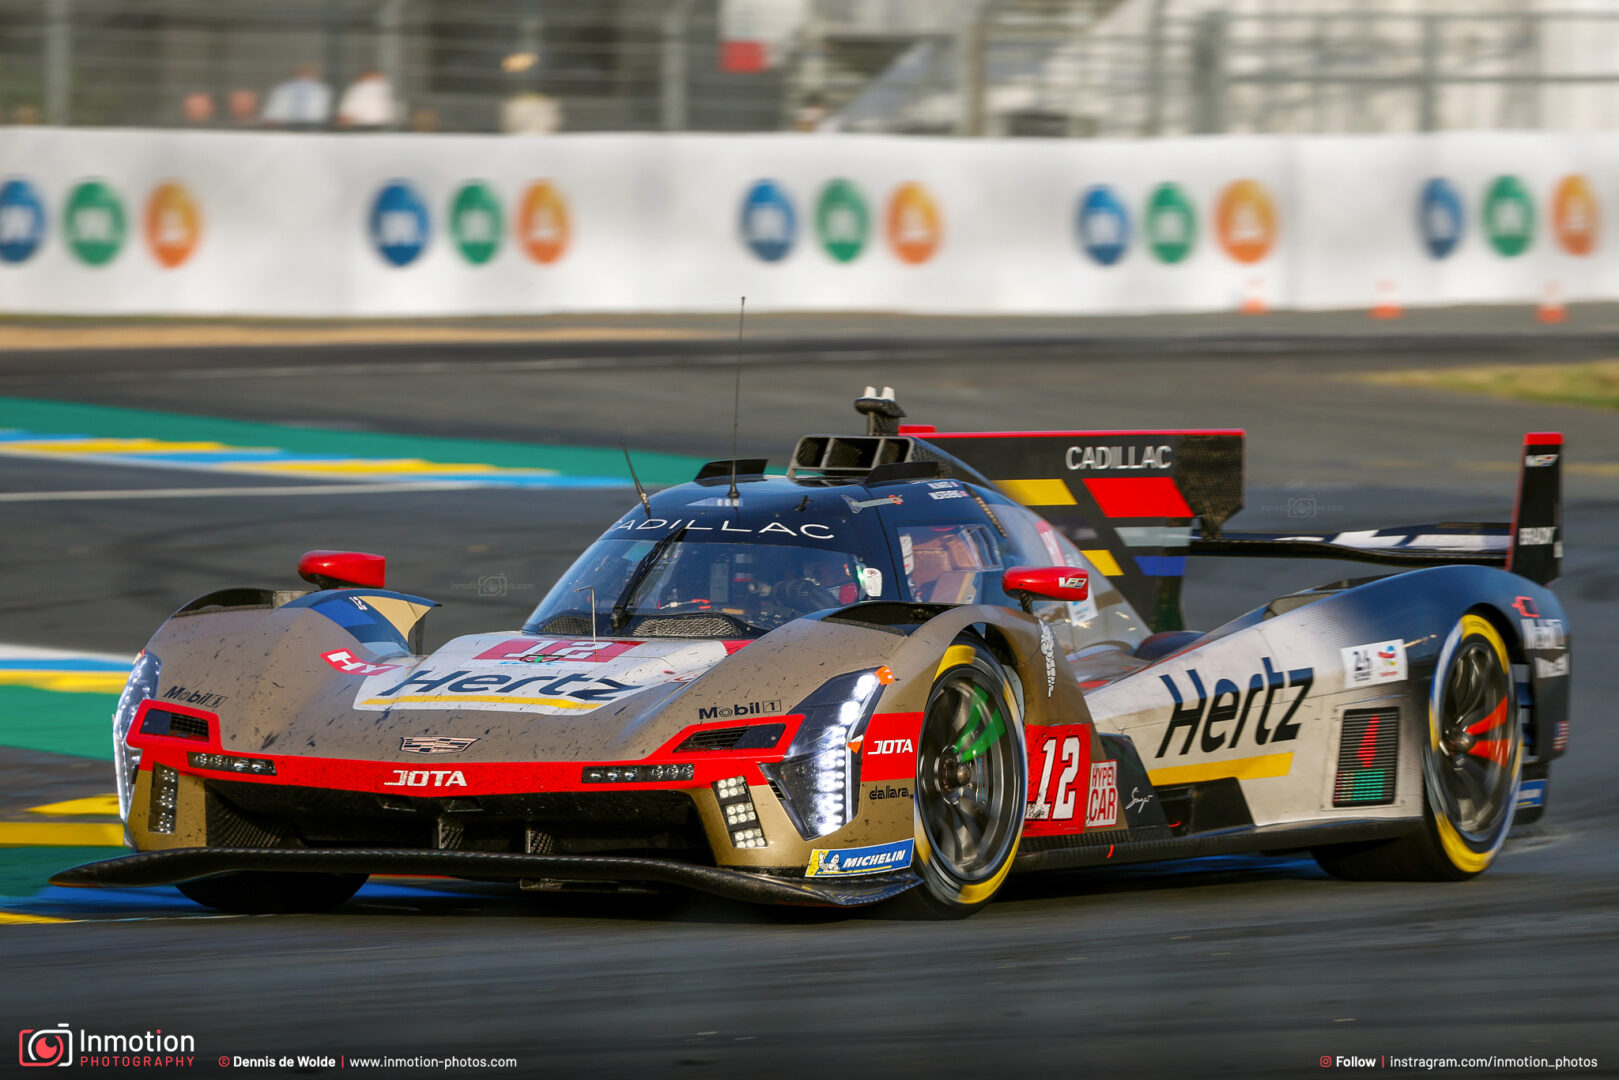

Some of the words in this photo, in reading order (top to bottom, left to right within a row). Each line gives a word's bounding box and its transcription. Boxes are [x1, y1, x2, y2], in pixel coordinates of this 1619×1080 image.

[1065, 445, 1172, 470] CADILLAC
[611, 518, 835, 540] ADILLAC
[502, 640, 616, 660] 12
[163, 685, 214, 705] Mobil
[377, 670, 645, 701] Hertz
[698, 702, 760, 720] Mobil
[1155, 657, 1316, 758] Hertz
[867, 739, 913, 755] JOTA
[384, 770, 467, 787] JOTA
[1025, 735, 1081, 821] 12
[1088, 788, 1117, 822] CAR
[842, 849, 906, 868] MICHELIN
